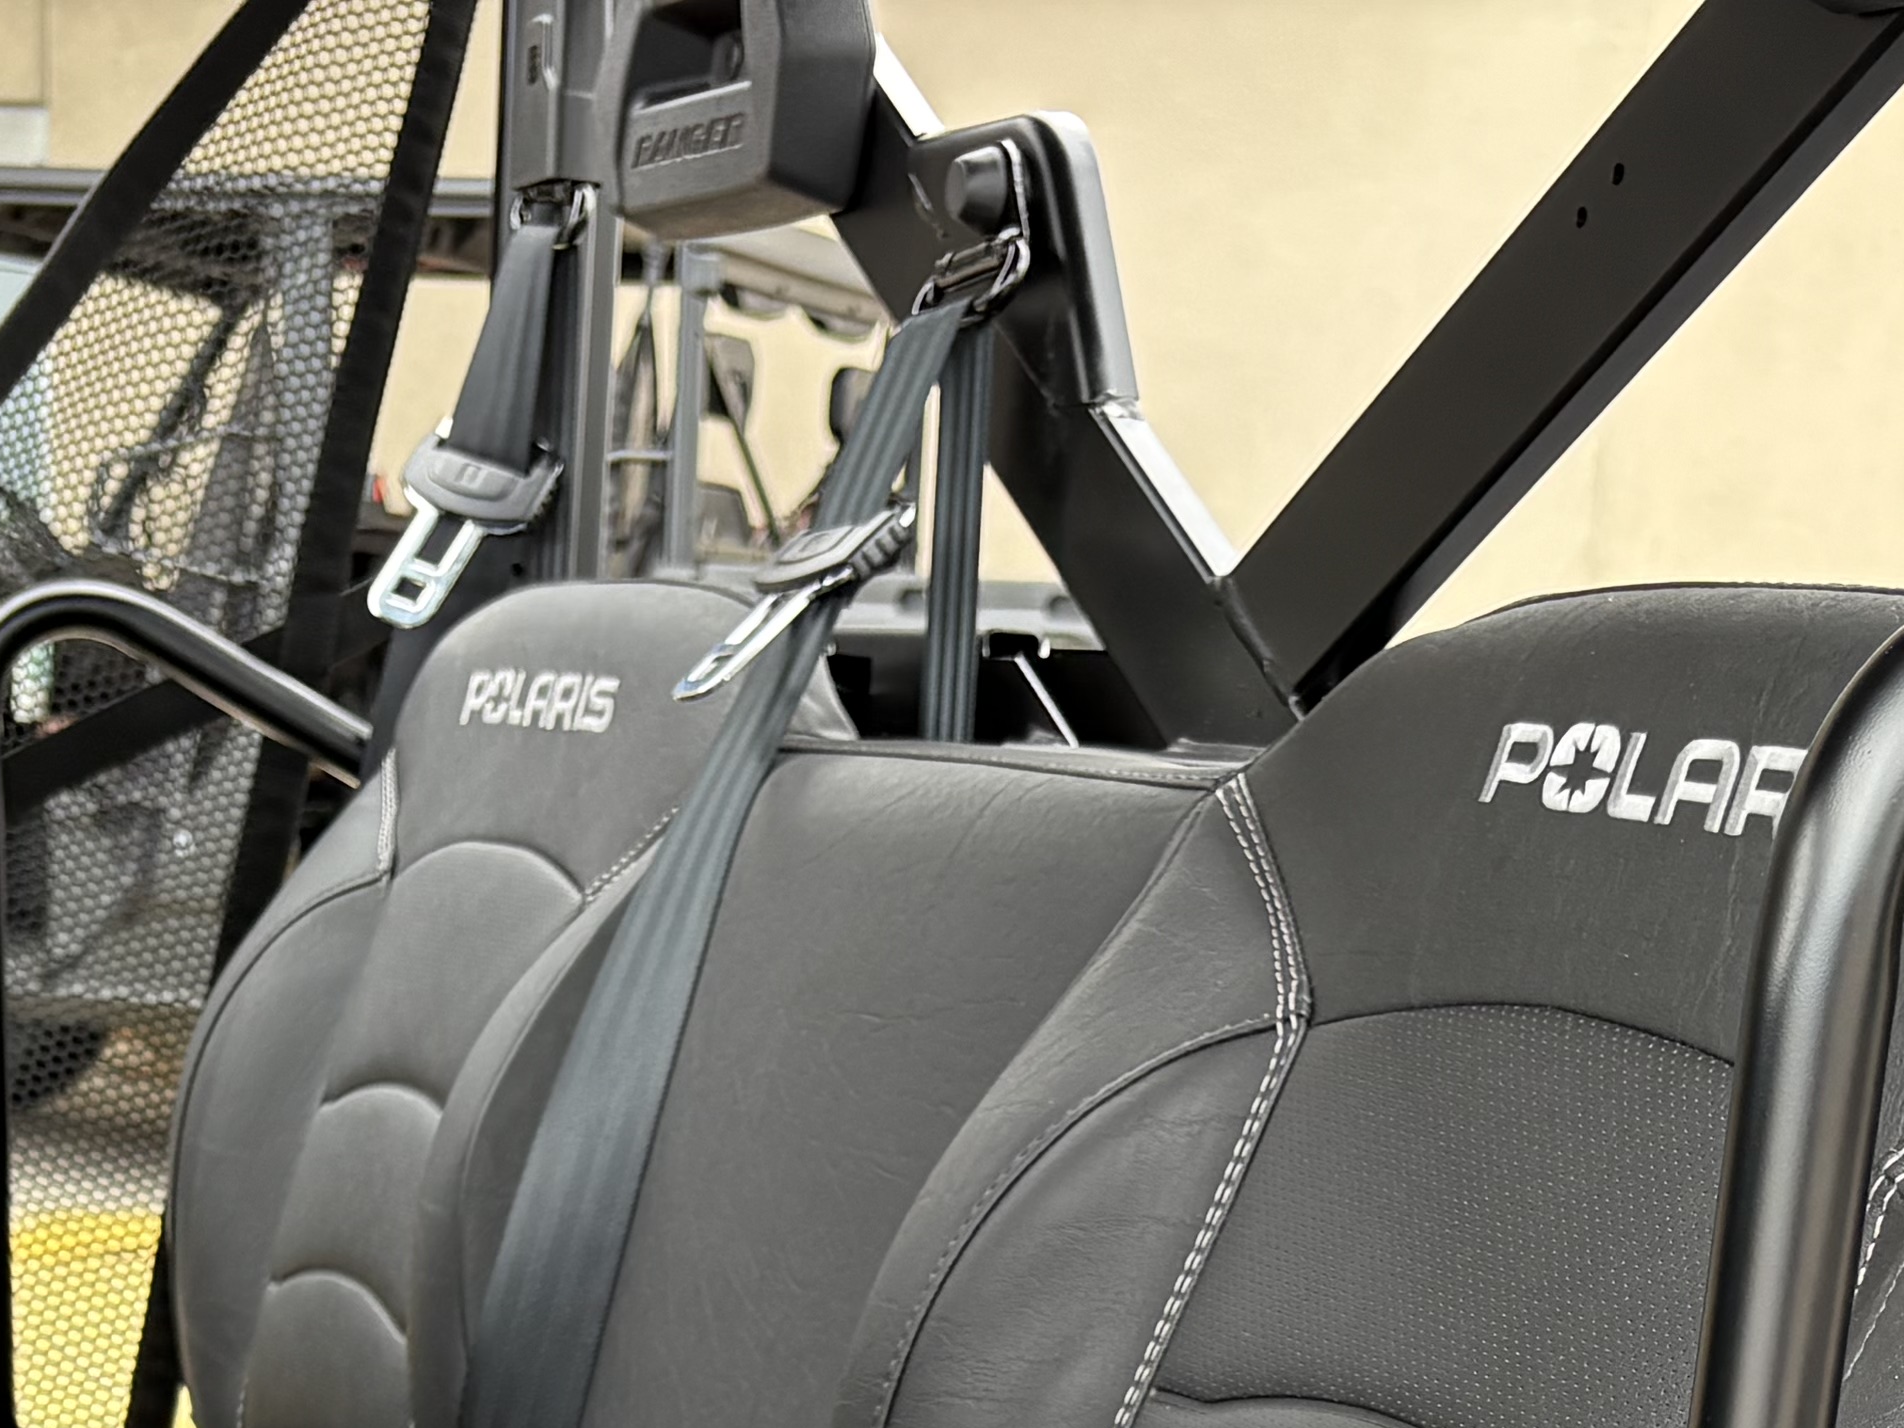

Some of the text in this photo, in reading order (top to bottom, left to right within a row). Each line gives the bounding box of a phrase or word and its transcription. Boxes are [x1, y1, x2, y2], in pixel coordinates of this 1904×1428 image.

[630, 112, 746, 171] RANGER
[458, 667, 621, 734] POLARIS
[1477, 721, 1809, 838] POLAR
